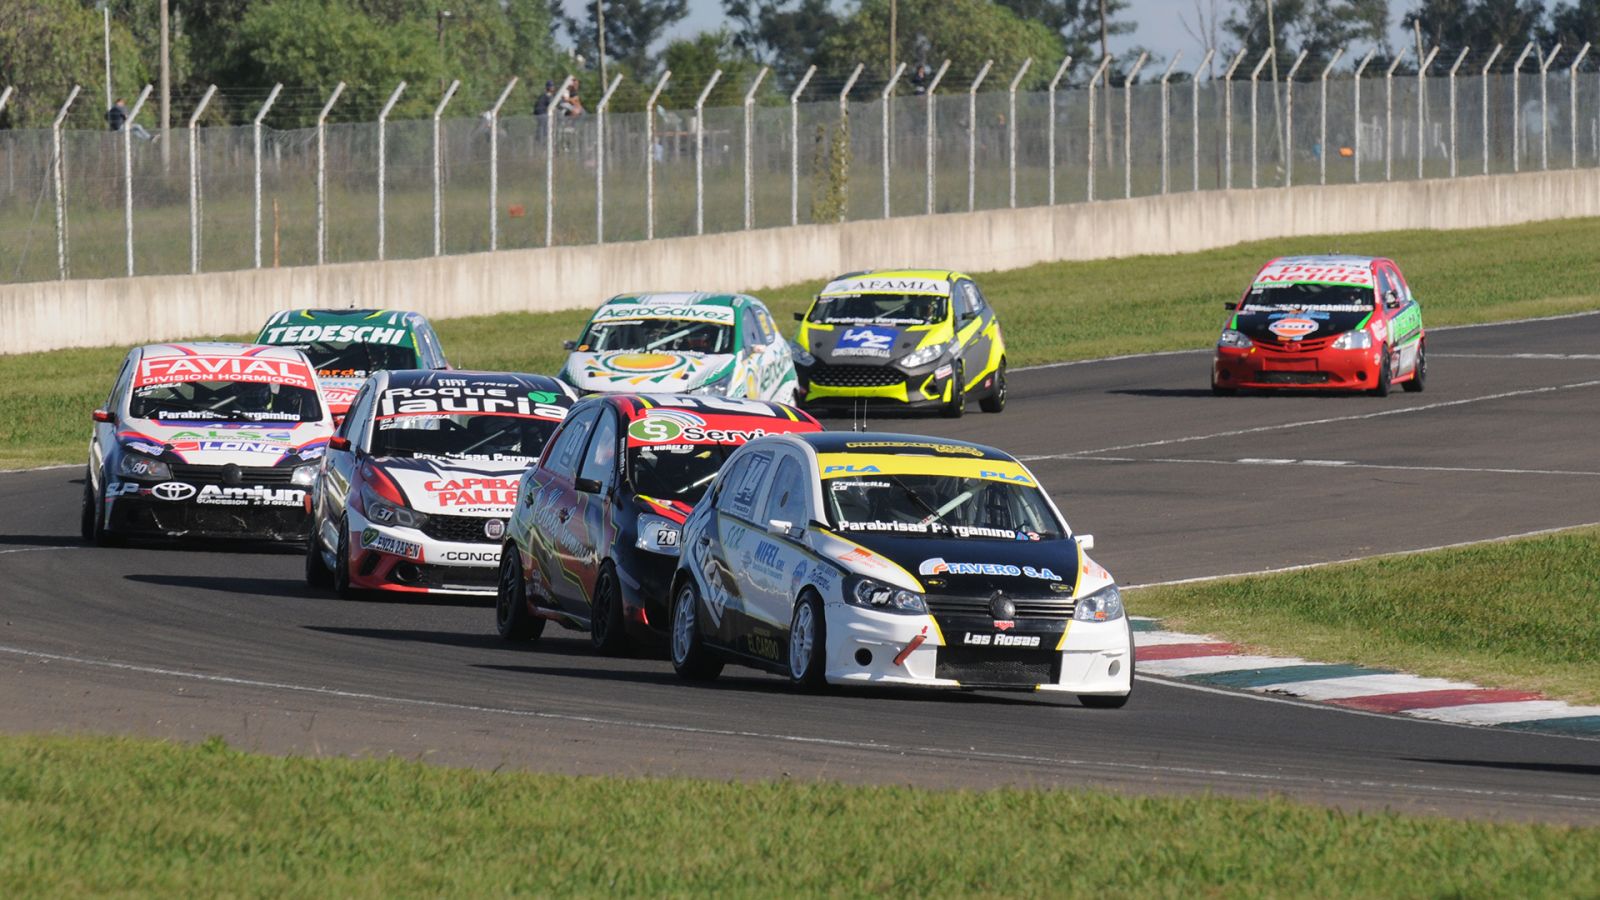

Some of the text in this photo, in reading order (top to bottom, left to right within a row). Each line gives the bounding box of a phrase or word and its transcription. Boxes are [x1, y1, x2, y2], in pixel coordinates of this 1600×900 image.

[852, 281, 939, 291] AFAMIA
[600, 305, 731, 321] AeroGalvez
[267, 325, 406, 345] TEDESCHI
[843, 329, 892, 349] LAZ
[141, 359, 306, 382] FAVIAL
[142, 374, 213, 385] DIVISION
[217, 373, 308, 387] HORMIGON
[438, 378, 467, 387] FIAT
[385, 387, 507, 400] Roque
[382, 396, 568, 420] lauria
[132, 463, 148, 474] 80
[824, 464, 1031, 483] PLA PLA
[196, 484, 306, 501] Amiun
[377, 508, 394, 521] 37
[838, 520, 928, 532] Parabrisas
[658, 531, 676, 545] 28
[947, 562, 1021, 577] FAVERO
[1022, 565, 1063, 582] S.A.
[963, 632, 1041, 647] Las Rosas
